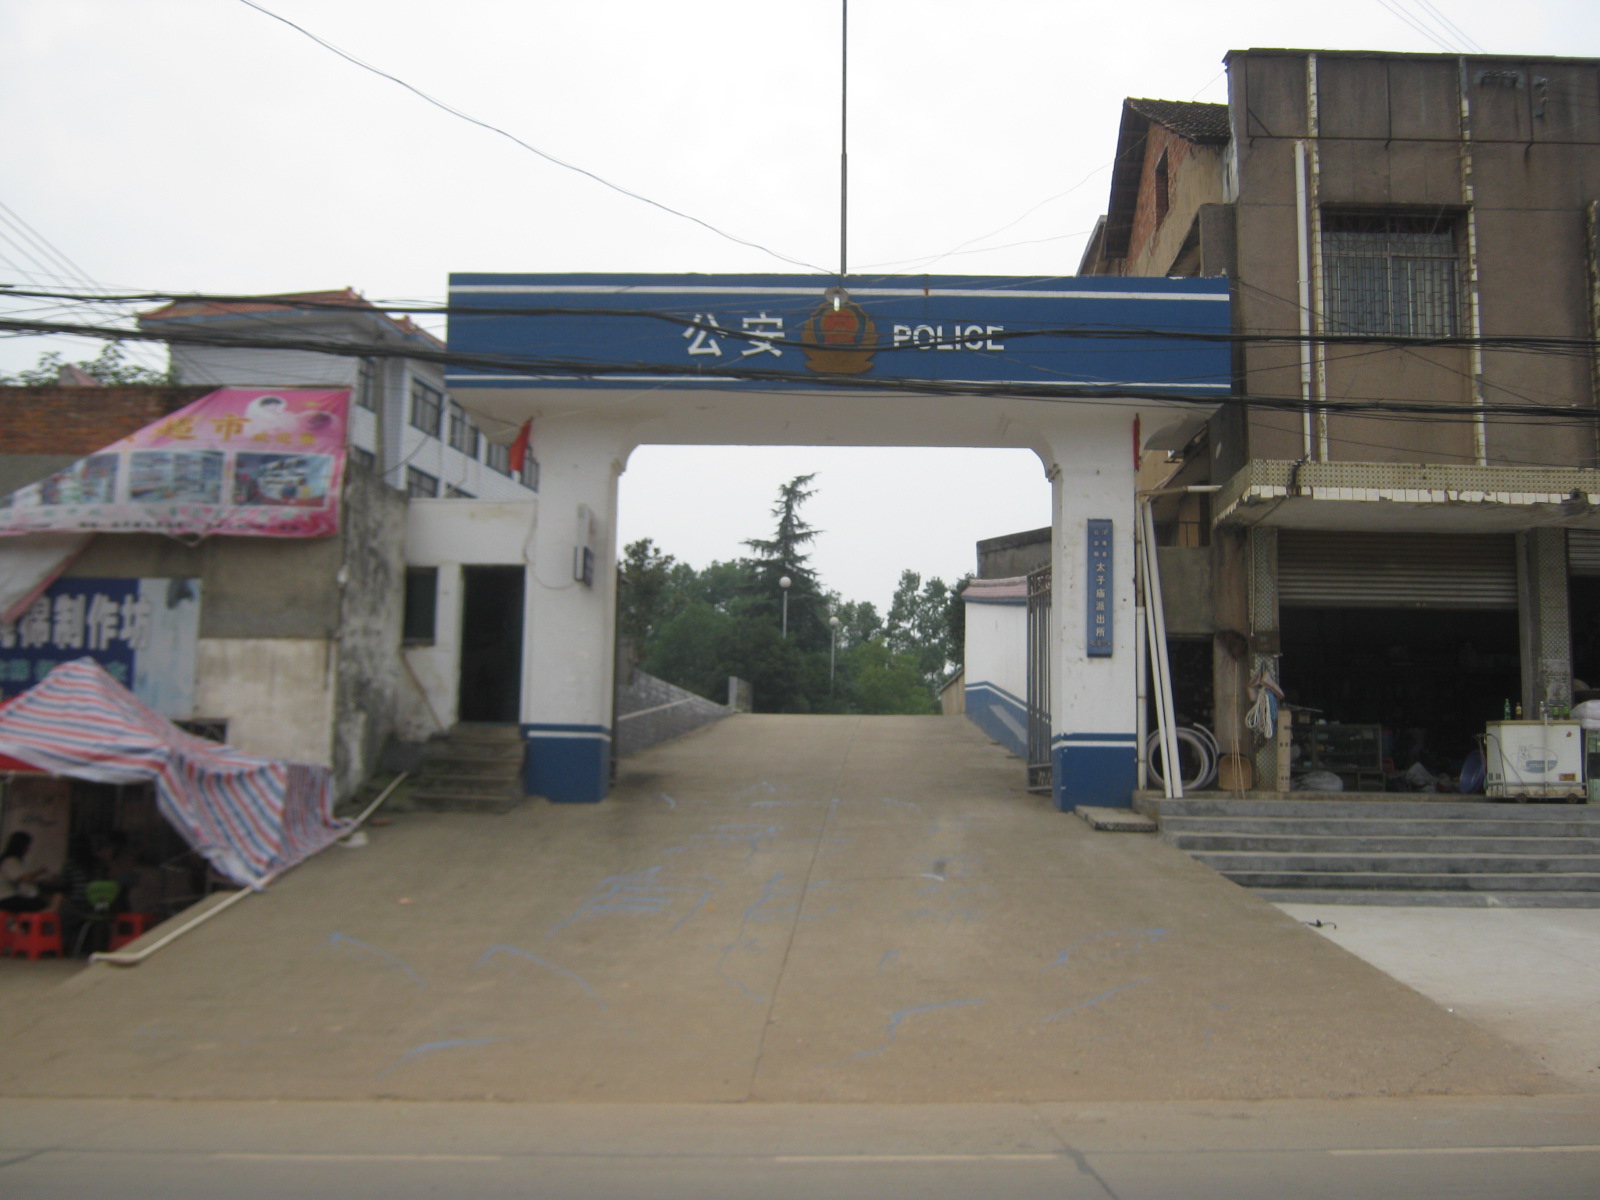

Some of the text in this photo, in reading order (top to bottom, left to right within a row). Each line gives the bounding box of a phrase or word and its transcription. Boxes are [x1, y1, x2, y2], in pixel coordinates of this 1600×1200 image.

[682, 312, 786, 358] 公安
[893, 324, 1005, 351] POLICE
[124, 413, 252, 442] 超市
[1096, 562, 1106, 637] 太子庙派出所
